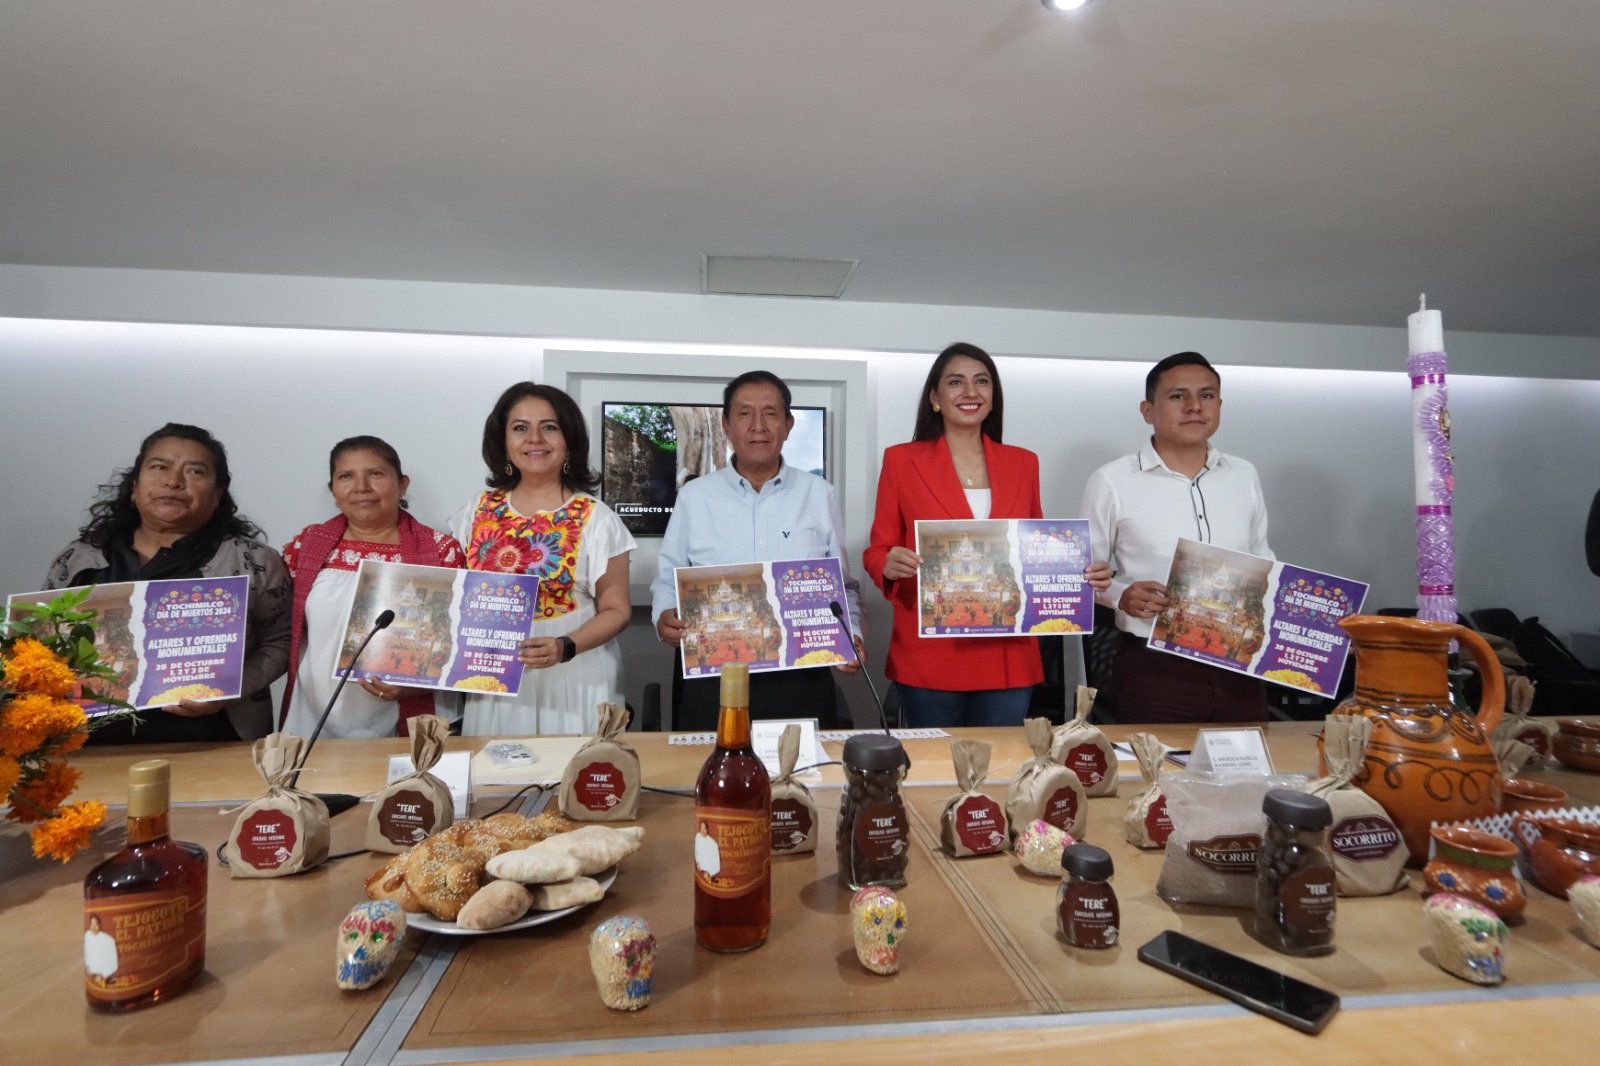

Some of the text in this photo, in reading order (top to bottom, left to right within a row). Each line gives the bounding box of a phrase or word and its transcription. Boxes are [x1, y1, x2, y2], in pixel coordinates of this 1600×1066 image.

[1026, 574, 1050, 583] ALTARES
[1033, 584, 1081, 592] MONUMENTALES
[477, 595, 519, 604] TOCHIMILCO
[1293, 591, 1339, 608] TOCHIMILCO
[166, 601, 224, 610] TOCHIMILCO
[488, 602, 511, 611] MUERTOS
[1295, 598, 1303, 606] DE
[1303, 599, 1329, 613] MUERTOS
[1329, 607, 1344, 617] 2024
[171, 610, 180, 618] DE
[182, 608, 213, 617] MUERTOS
[214, 607, 231, 615] 2024
[784, 609, 807, 619] ALTARES
[814, 608, 832, 617] OFREN
[792, 616, 838, 627] MONUMENTALES
[460, 627, 487, 638] ALTARES
[494, 630, 525, 641] OFRENDAS
[1273, 620, 1301, 634] ALTARES
[1308, 629, 1344, 645] OFRENDAS
[148, 637, 184, 650] ALTARES
[194, 633, 238, 645] OFRENDAS
[466, 637, 516, 650] MONUMENTALES
[801, 640, 836, 648] NOVIEMBRE
[1279, 630, 1333, 652] MONUMENTALES
[157, 644, 227, 658] MONUMENTALES
[1286, 646, 1296, 654] DE
[1296, 649, 1329, 663] OCTUBRE
[484, 653, 514, 661] OCTUBRE
[1305, 658, 1315, 666] DE
[184, 658, 225, 668] OCTUBRE
[1278, 657, 1319, 673] NOVIEMBRE
[467, 665, 505, 674] NOVIEMBRE
[163, 673, 215, 683] NOVIEMBRE
[1333, 831, 1396, 848] SOCORRITO
[1195, 848, 1255, 862] SOCORRI
[1078, 897, 1108, 909] "TERE"
[116, 930, 131, 941] EL
